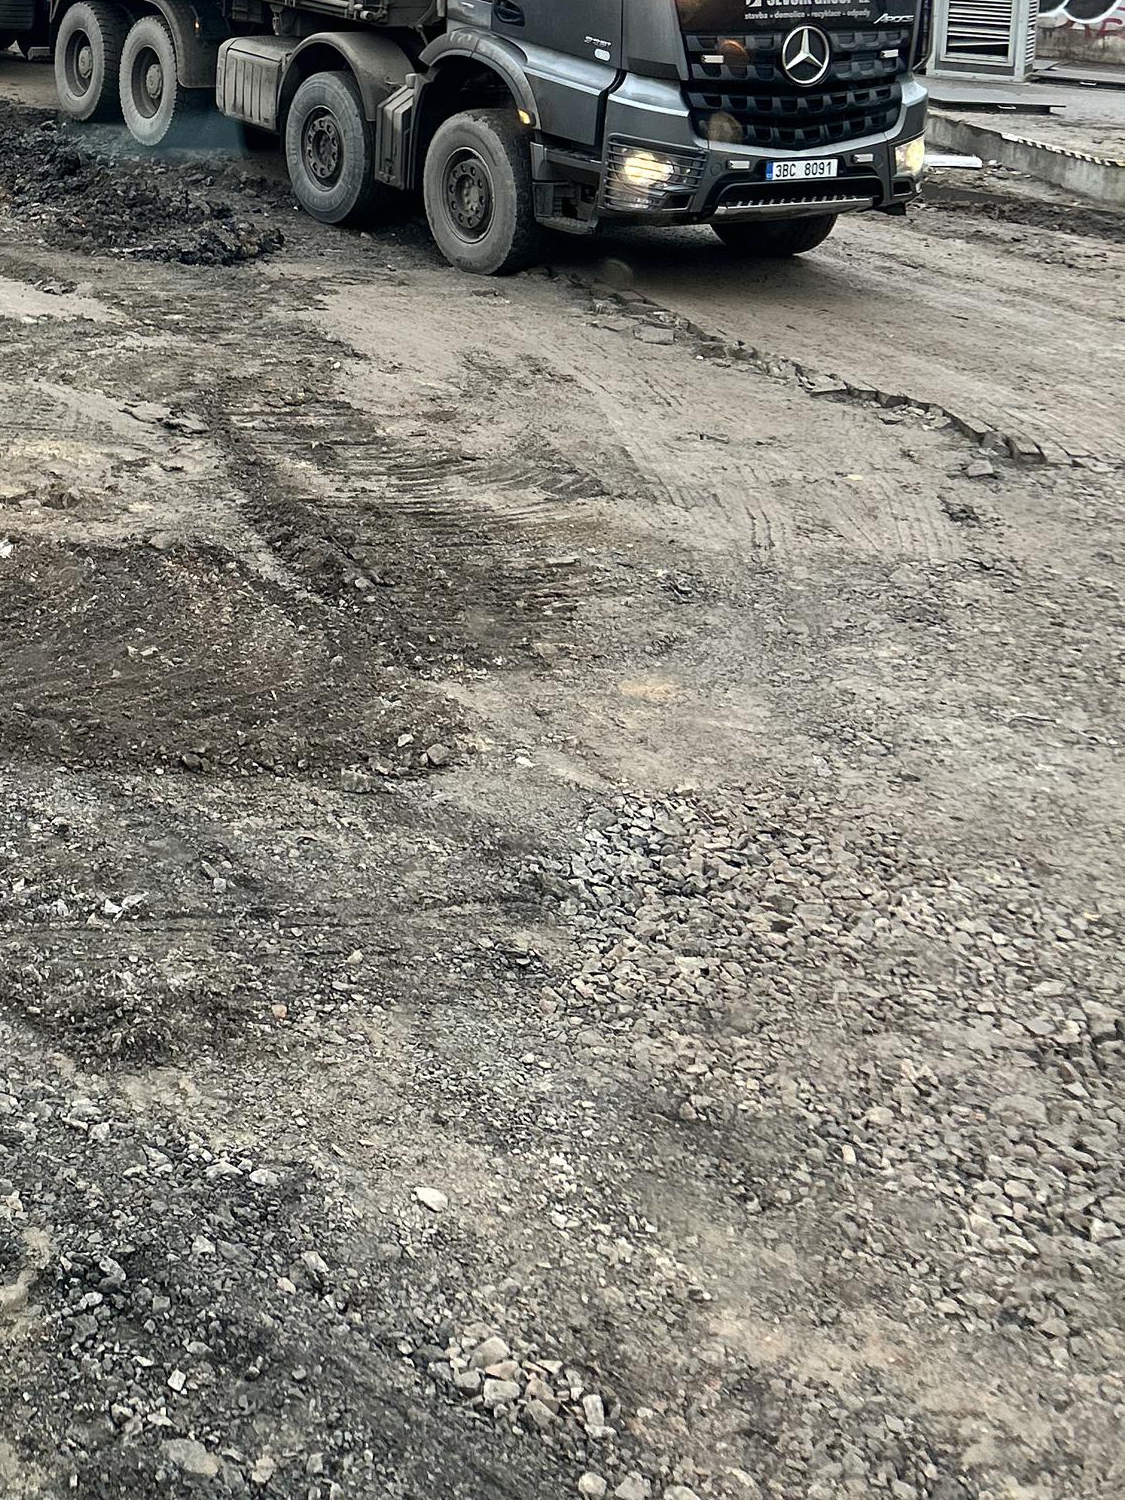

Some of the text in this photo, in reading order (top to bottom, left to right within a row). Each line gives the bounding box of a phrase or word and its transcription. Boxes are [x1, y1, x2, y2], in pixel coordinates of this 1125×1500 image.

[744, 8, 871, 20] stavba demolice recyklace odpady
[775, 163, 797, 178] 3BC
[804, 161, 832, 176] 8091
